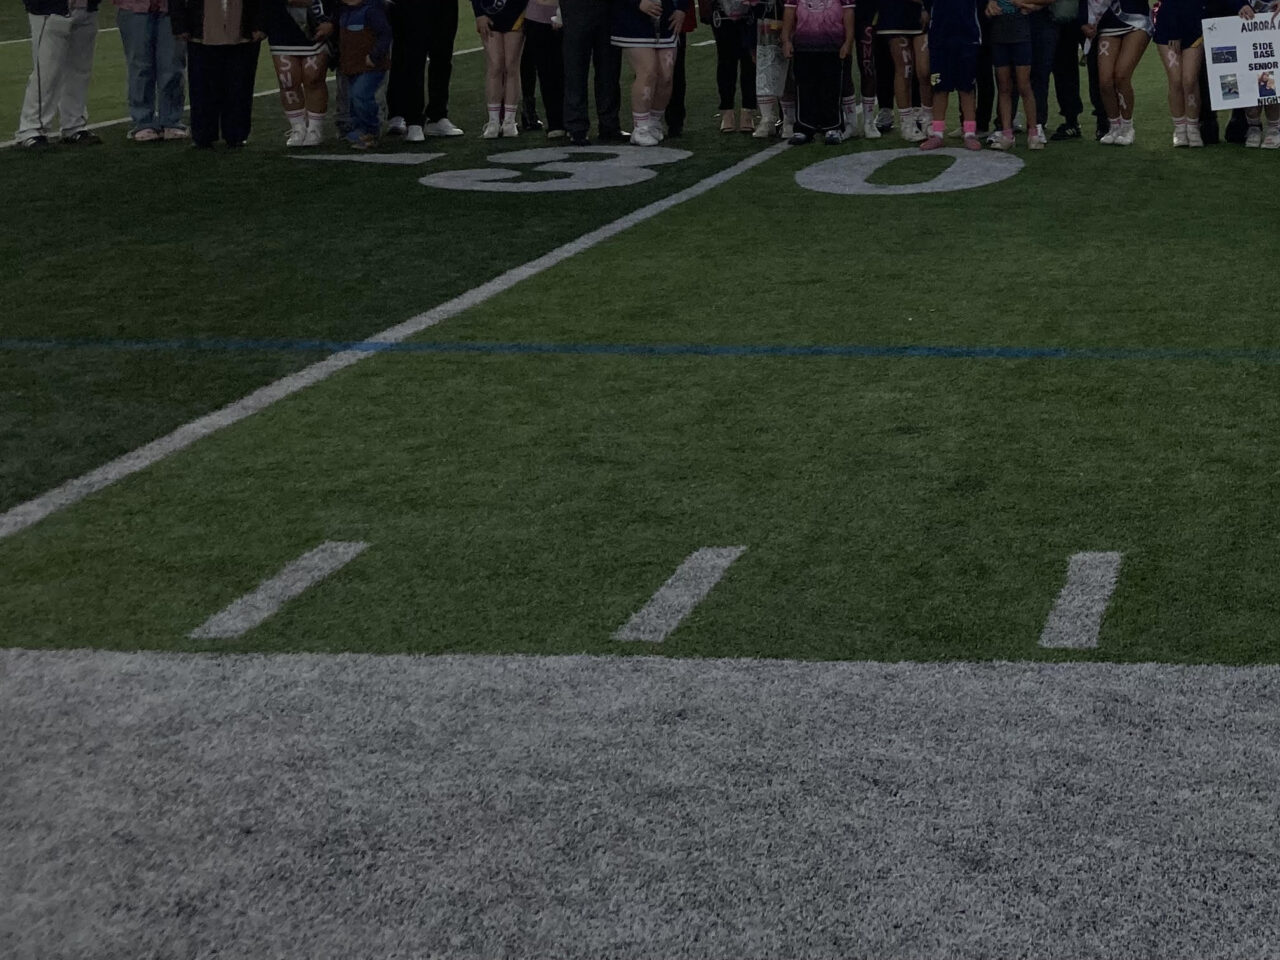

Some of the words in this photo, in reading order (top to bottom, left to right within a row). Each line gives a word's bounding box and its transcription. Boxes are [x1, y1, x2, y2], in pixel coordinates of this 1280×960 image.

[1241, 21, 1276, 32] AURORA
[1252, 43, 1274, 51] SIDE
[1253, 50, 1275, 59] BASE
[1248, 61, 1279, 71] SENIOR
